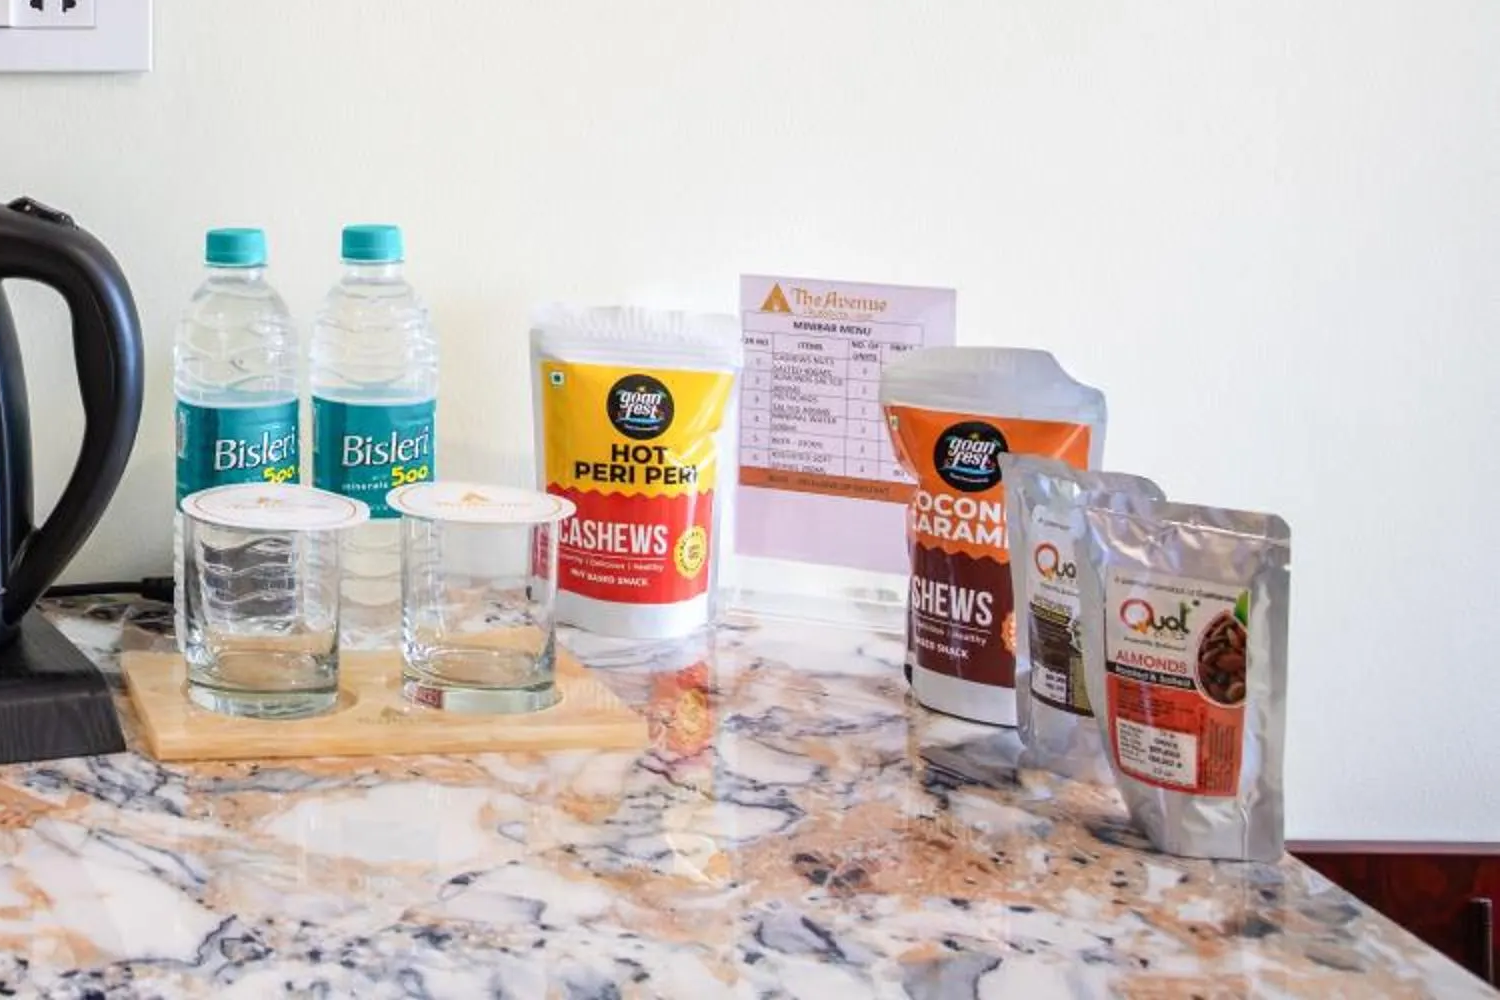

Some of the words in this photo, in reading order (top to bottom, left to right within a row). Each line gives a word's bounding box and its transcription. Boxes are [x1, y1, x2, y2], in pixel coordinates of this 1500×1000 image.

[791, 288, 821, 305] The
[821, 292, 888, 312] Avenue
[839, 325, 872, 336] MENU
[620, 391, 661, 408] goan
[625, 403, 658, 419] fest
[214, 425, 296, 471] Bisleri
[342, 425, 429, 467] Bisleri
[611, 444, 668, 464] HOT
[948, 438, 996, 456] goan
[952, 451, 990, 470] fest
[391, 465, 429, 486] 500
[574, 461, 635, 484] PERI
[645, 464, 698, 485] PERI
[559, 518, 669, 555] CASHEWS
[1115, 649, 1188, 674] ALMONDS
